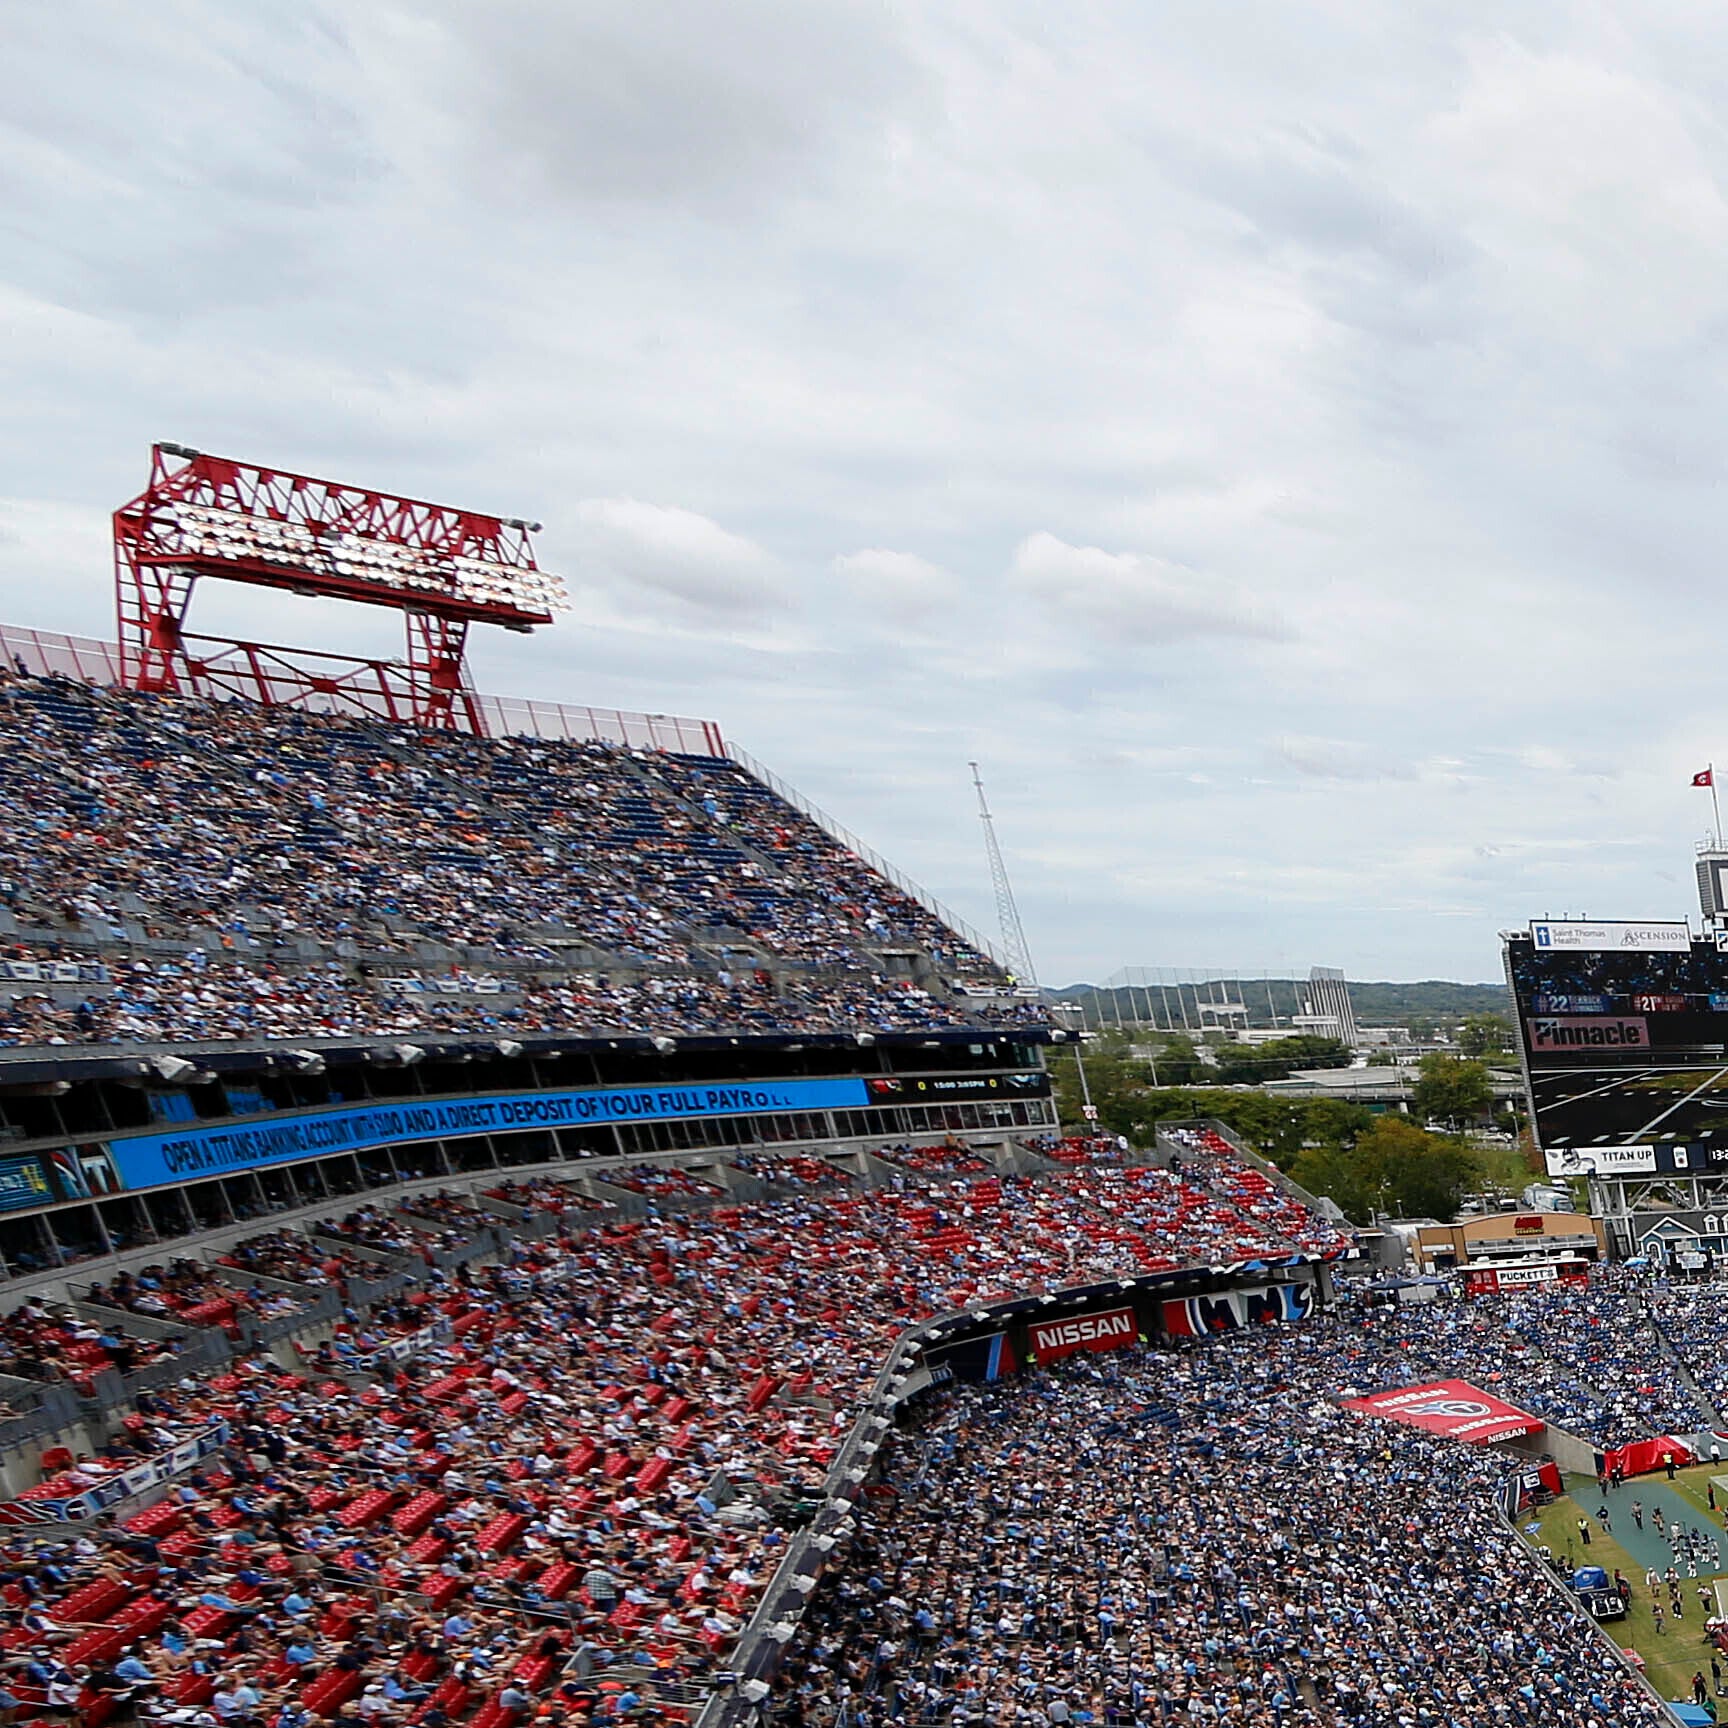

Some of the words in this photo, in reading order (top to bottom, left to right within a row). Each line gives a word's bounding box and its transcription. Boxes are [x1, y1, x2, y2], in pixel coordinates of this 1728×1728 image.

[1536, 1021, 1640, 1046] Pinnacle
[163, 1140, 197, 1173] OPEN
[199, 1138, 213, 1167] A
[214, 1131, 254, 1165] TITANS
[255, 1125, 304, 1160] BANKING
[305, 1120, 349, 1155] ACCOUNT
[352, 1118, 375, 1148] WITH
[377, 1113, 401, 1143] $100
[407, 1107, 434, 1134] AND
[436, 1105, 449, 1128] A
[450, 1099, 497, 1127] DIRECT
[501, 1094, 573, 1124] DEPOSIT
[576, 1093, 598, 1115] OF
[600, 1091, 654, 1115] YOUR
[660, 1089, 703, 1112] FULL
[708, 1087, 792, 1110] PAYROLL
[1601, 1151, 1635, 1162] TITAN
[1638, 1151, 1652, 1161] UP
[1037, 1315, 1131, 1349] NISSAN
[1374, 1389, 1449, 1407] NISSAN
[1449, 1415, 1524, 1434] NISSAN
[1488, 1428, 1526, 1443] NISSAN
